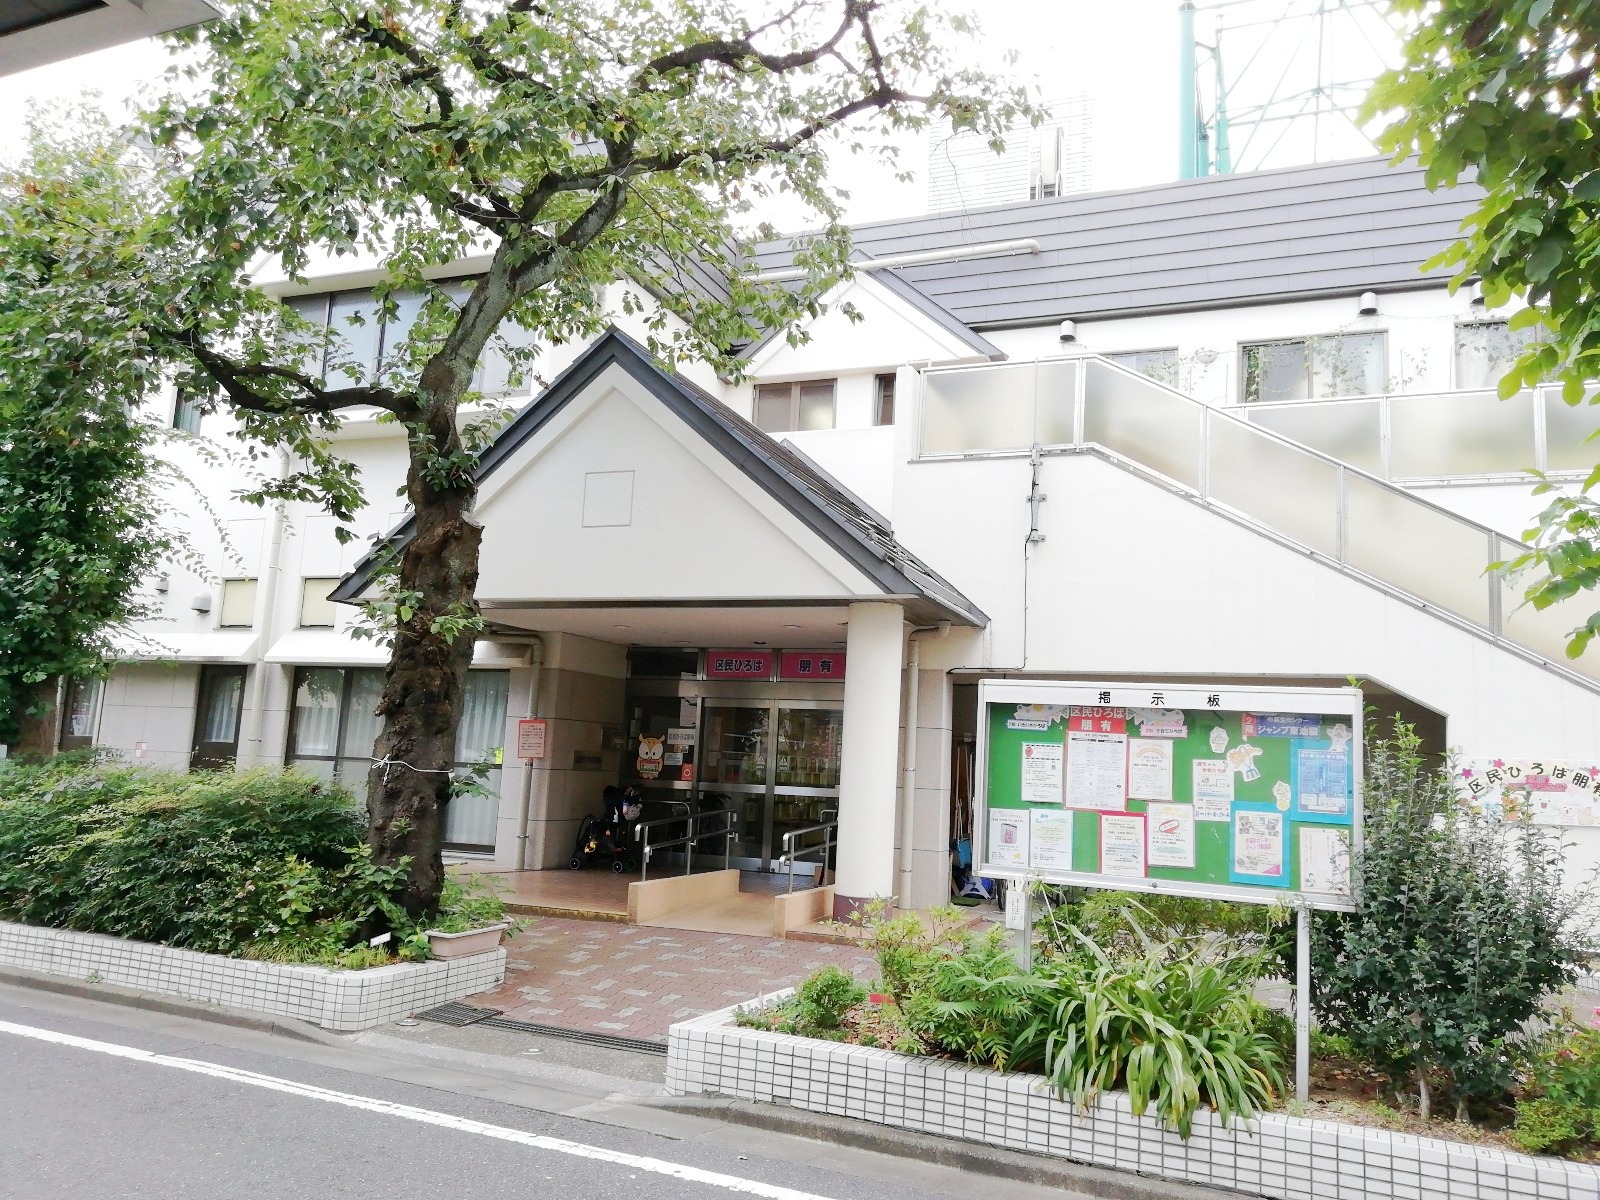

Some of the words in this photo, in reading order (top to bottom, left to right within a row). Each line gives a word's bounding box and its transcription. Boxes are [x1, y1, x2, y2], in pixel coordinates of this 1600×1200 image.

[715, 658, 763, 672] 区民ひろば
[799, 658, 832, 673] 朋有
[1070, 706, 1125, 718] 区民ひろば
[1081, 719, 1111, 732] 朋有
[1257, 725, 1319, 736] ジャンプ東池袋
